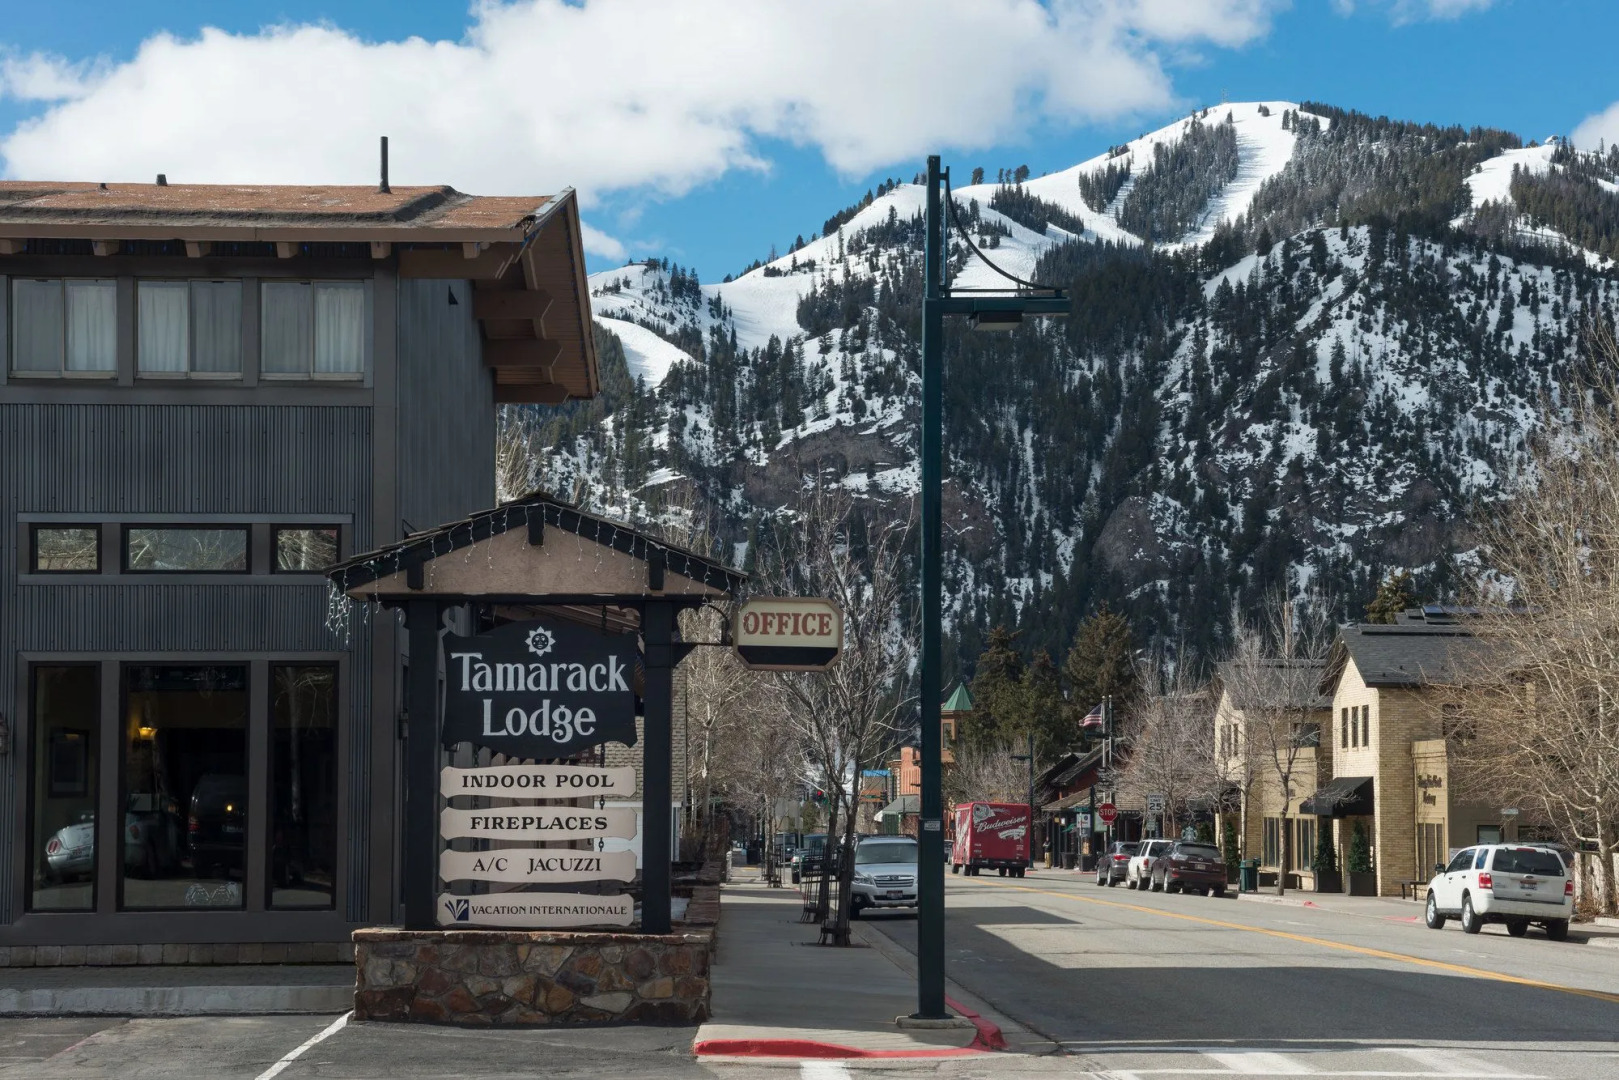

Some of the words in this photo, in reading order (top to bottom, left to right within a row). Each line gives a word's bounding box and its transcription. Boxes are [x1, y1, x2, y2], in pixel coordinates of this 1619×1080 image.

[743, 611, 833, 636] OFFICE
[451, 652, 630, 692] Tamarack
[482, 699, 596, 743] Lodge
[462, 774, 546, 788] INDOOR
[555, 774, 615, 788] POOL
[1150, 802, 1162, 810] 25
[470, 816, 608, 830] FIREPLACES
[976, 815, 1027, 833] Budweiser
[472, 857, 508, 872] A/C
[527, 857, 602, 875] JACUZZI
[471, 905, 526, 915] VACATION
[529, 905, 628, 915] INTERNATIONALE
